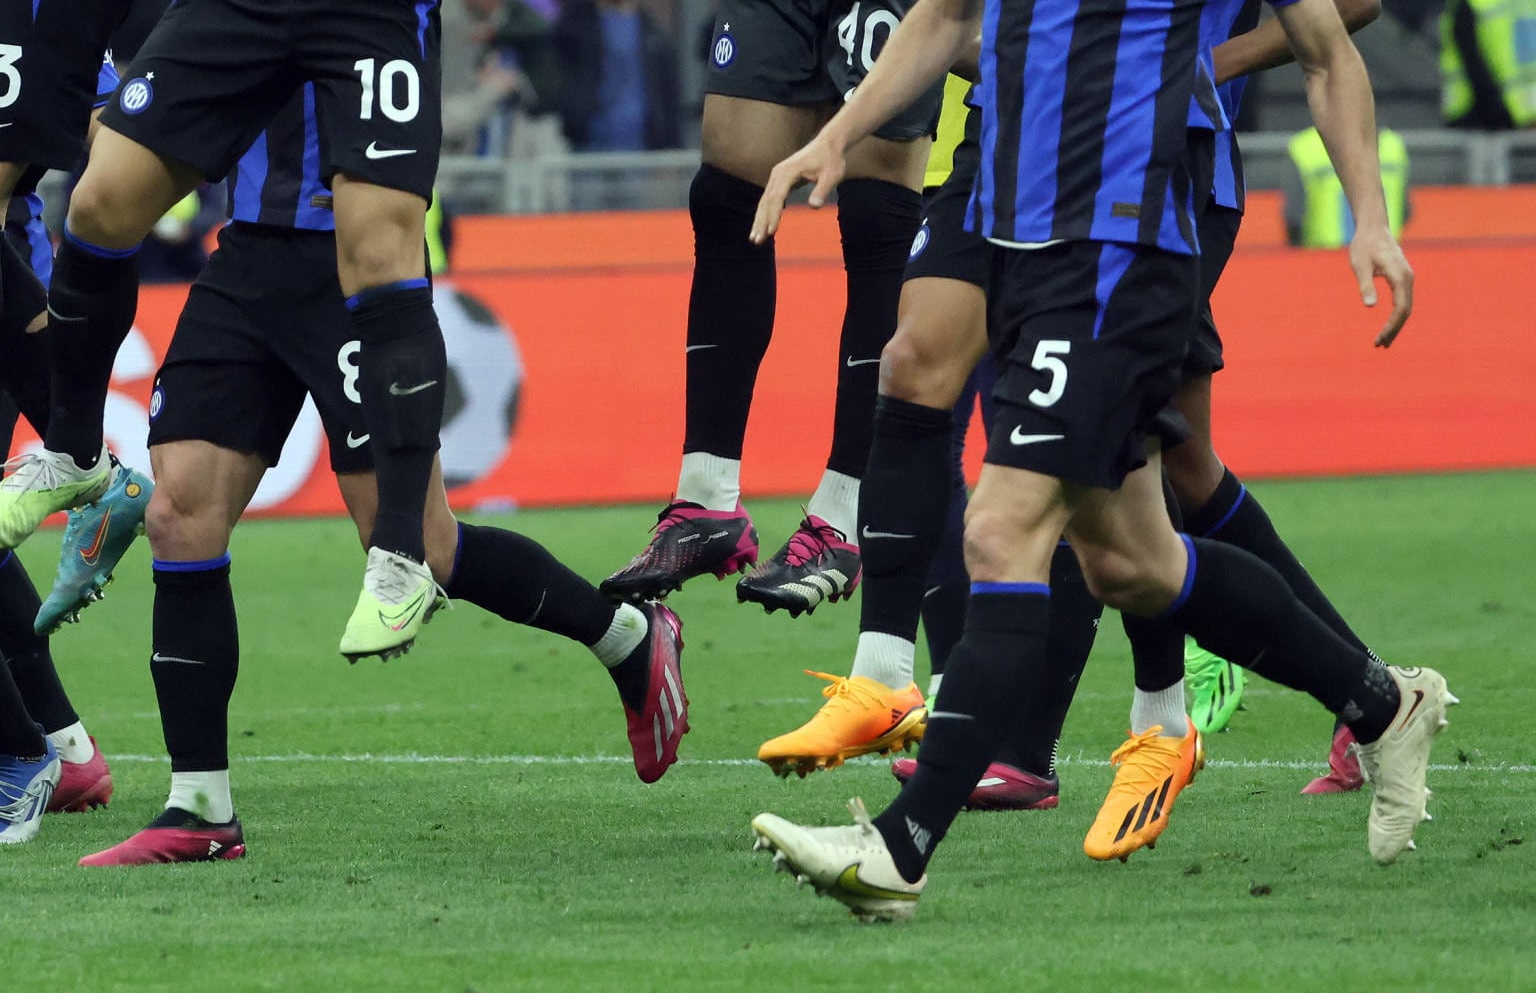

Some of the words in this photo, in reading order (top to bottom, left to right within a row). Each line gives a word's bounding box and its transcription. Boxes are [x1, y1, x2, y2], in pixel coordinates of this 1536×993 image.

[837, 1, 902, 74] 40
[353, 57, 421, 123] 10
[1028, 339, 1071, 408] 5
